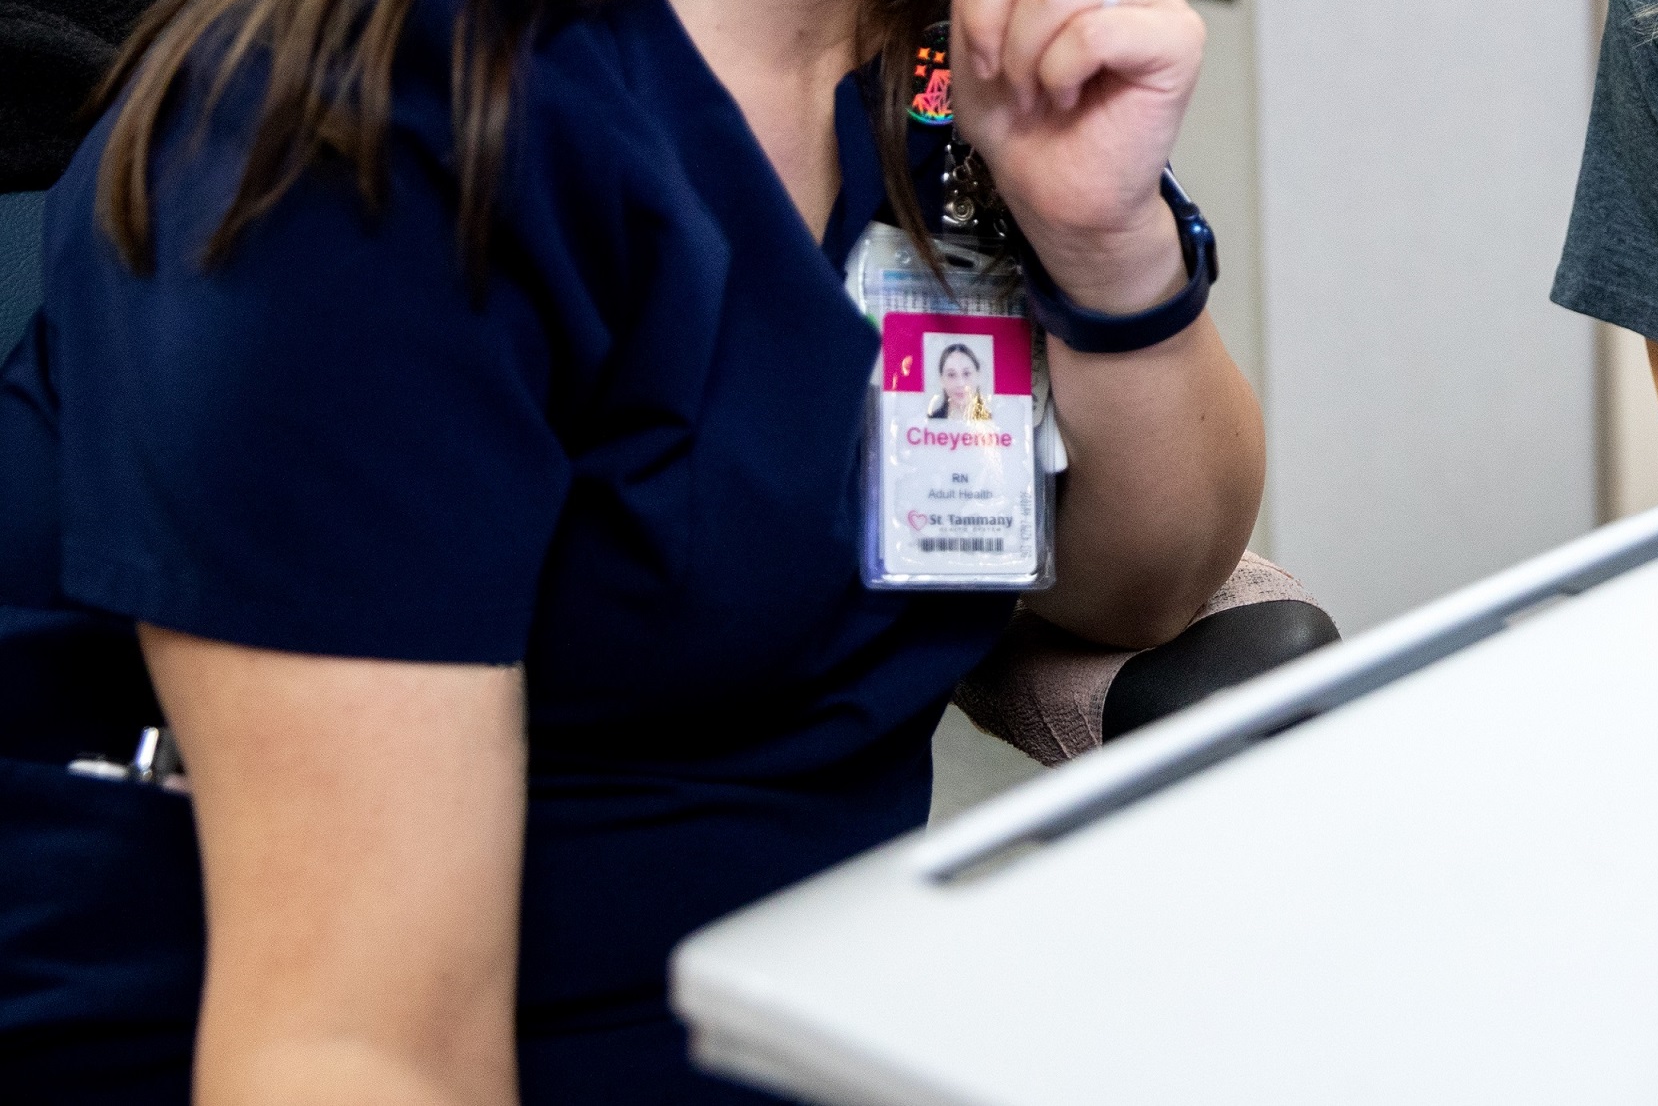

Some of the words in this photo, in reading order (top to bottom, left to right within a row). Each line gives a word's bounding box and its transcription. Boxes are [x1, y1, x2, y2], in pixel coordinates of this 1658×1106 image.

[951, 473, 969, 484] RN
[928, 490, 955, 500] Adult
[958, 489, 993, 500] Health
[947, 513, 1014, 529] Tammany
